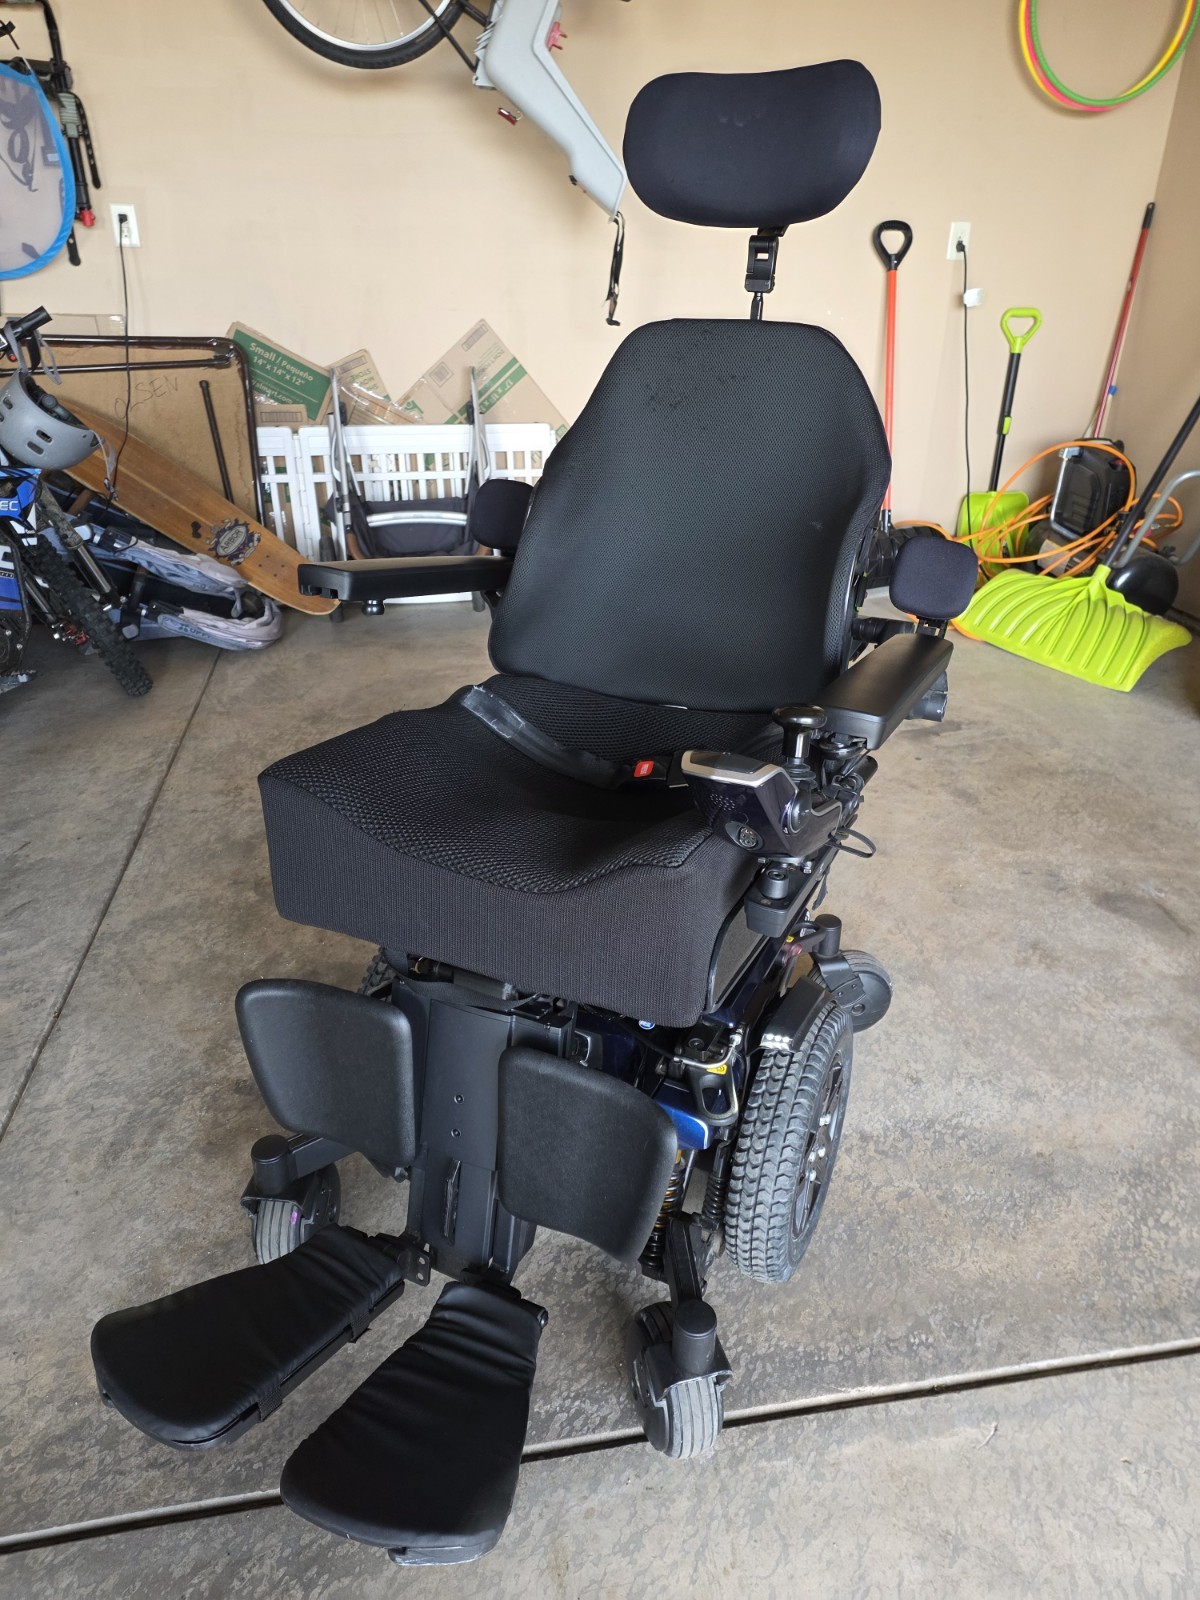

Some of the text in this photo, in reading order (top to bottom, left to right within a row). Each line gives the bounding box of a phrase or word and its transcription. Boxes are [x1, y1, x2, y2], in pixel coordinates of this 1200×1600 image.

[249, 342, 277, 361] Small
[281, 360, 314, 381] Pequeño
[253, 356, 267, 366] 14"
[273, 367, 286, 376] 14"
[292, 376, 305, 386] 12"
[221, 529, 241, 550] ARBOR
